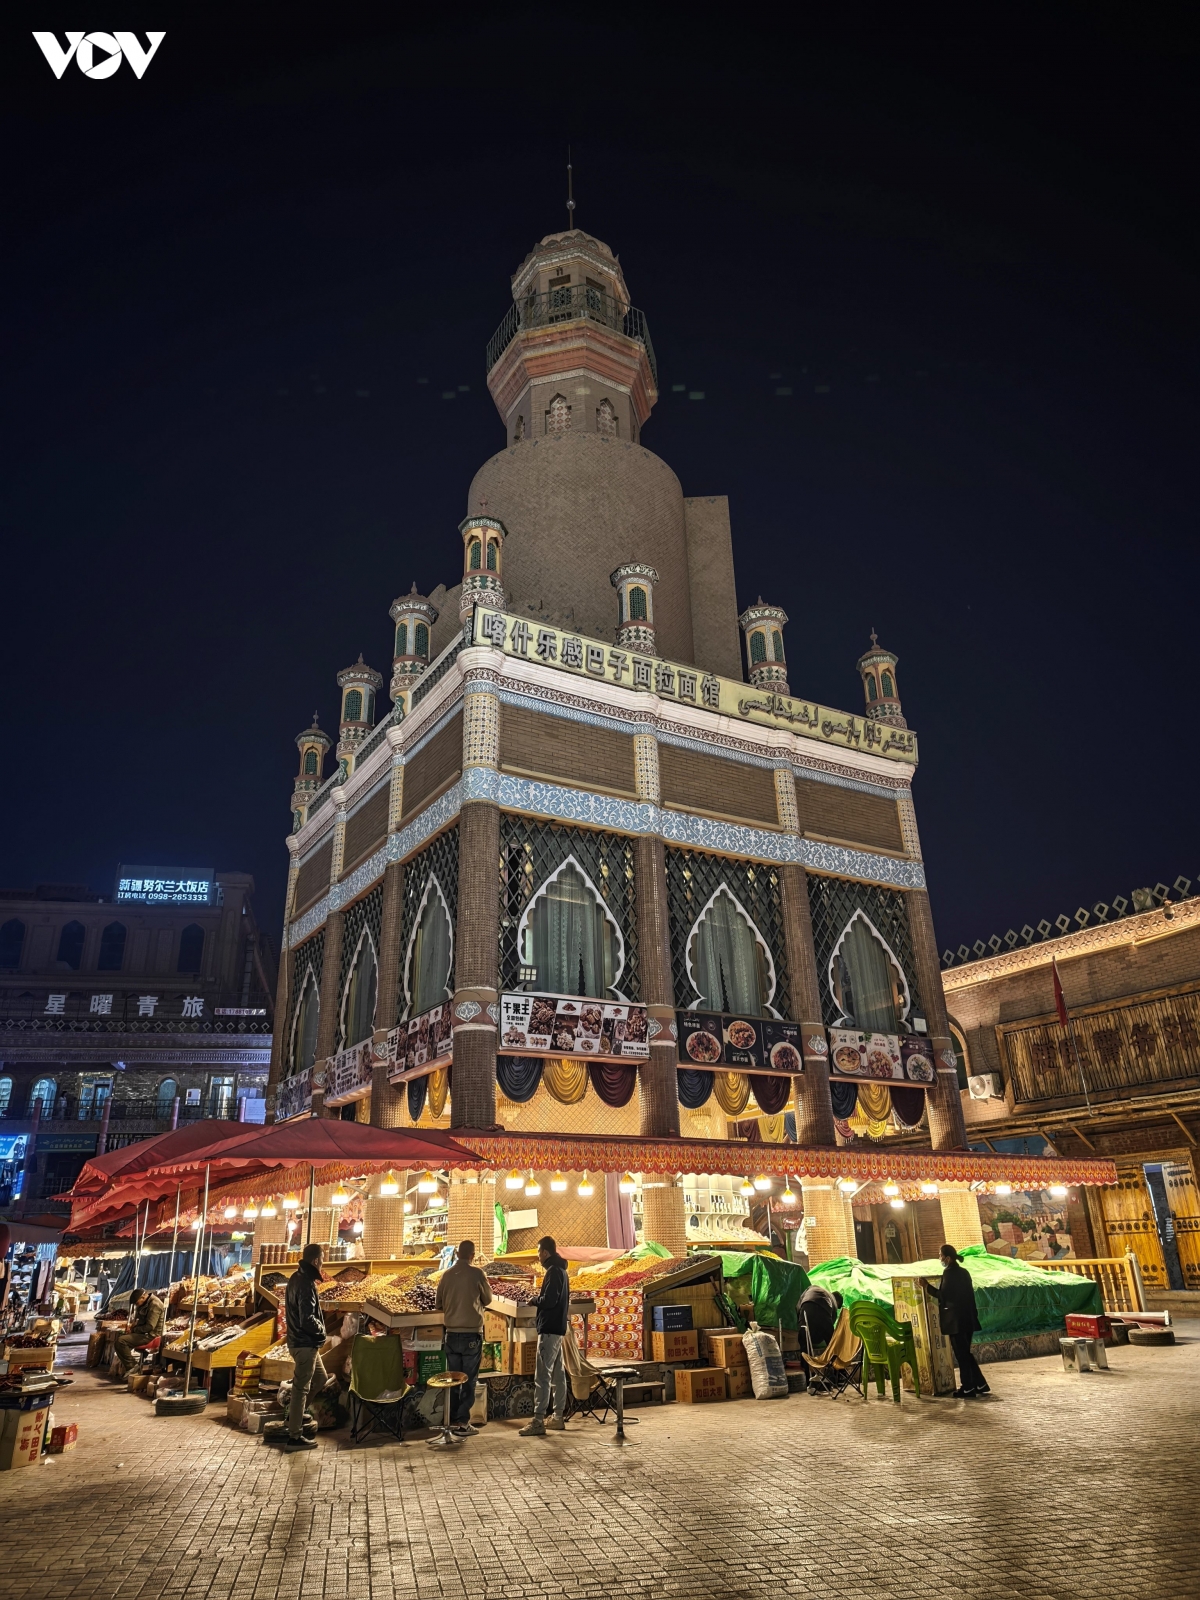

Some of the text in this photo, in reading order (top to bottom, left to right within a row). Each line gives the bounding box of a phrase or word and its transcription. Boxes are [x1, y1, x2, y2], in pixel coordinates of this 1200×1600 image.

[482, 613, 720, 707] 喀什乐感巴子面拉面馆
[44, 994, 205, 1017] 星曜青旅
[503, 1002, 530, 1015] 干果王
[673, 1335, 688, 1346] 新疆
[667, 1346, 695, 1357] 和田大枣
[702, 1376, 715, 1387] 新疆
[696, 1387, 723, 1398] 和田大枣
